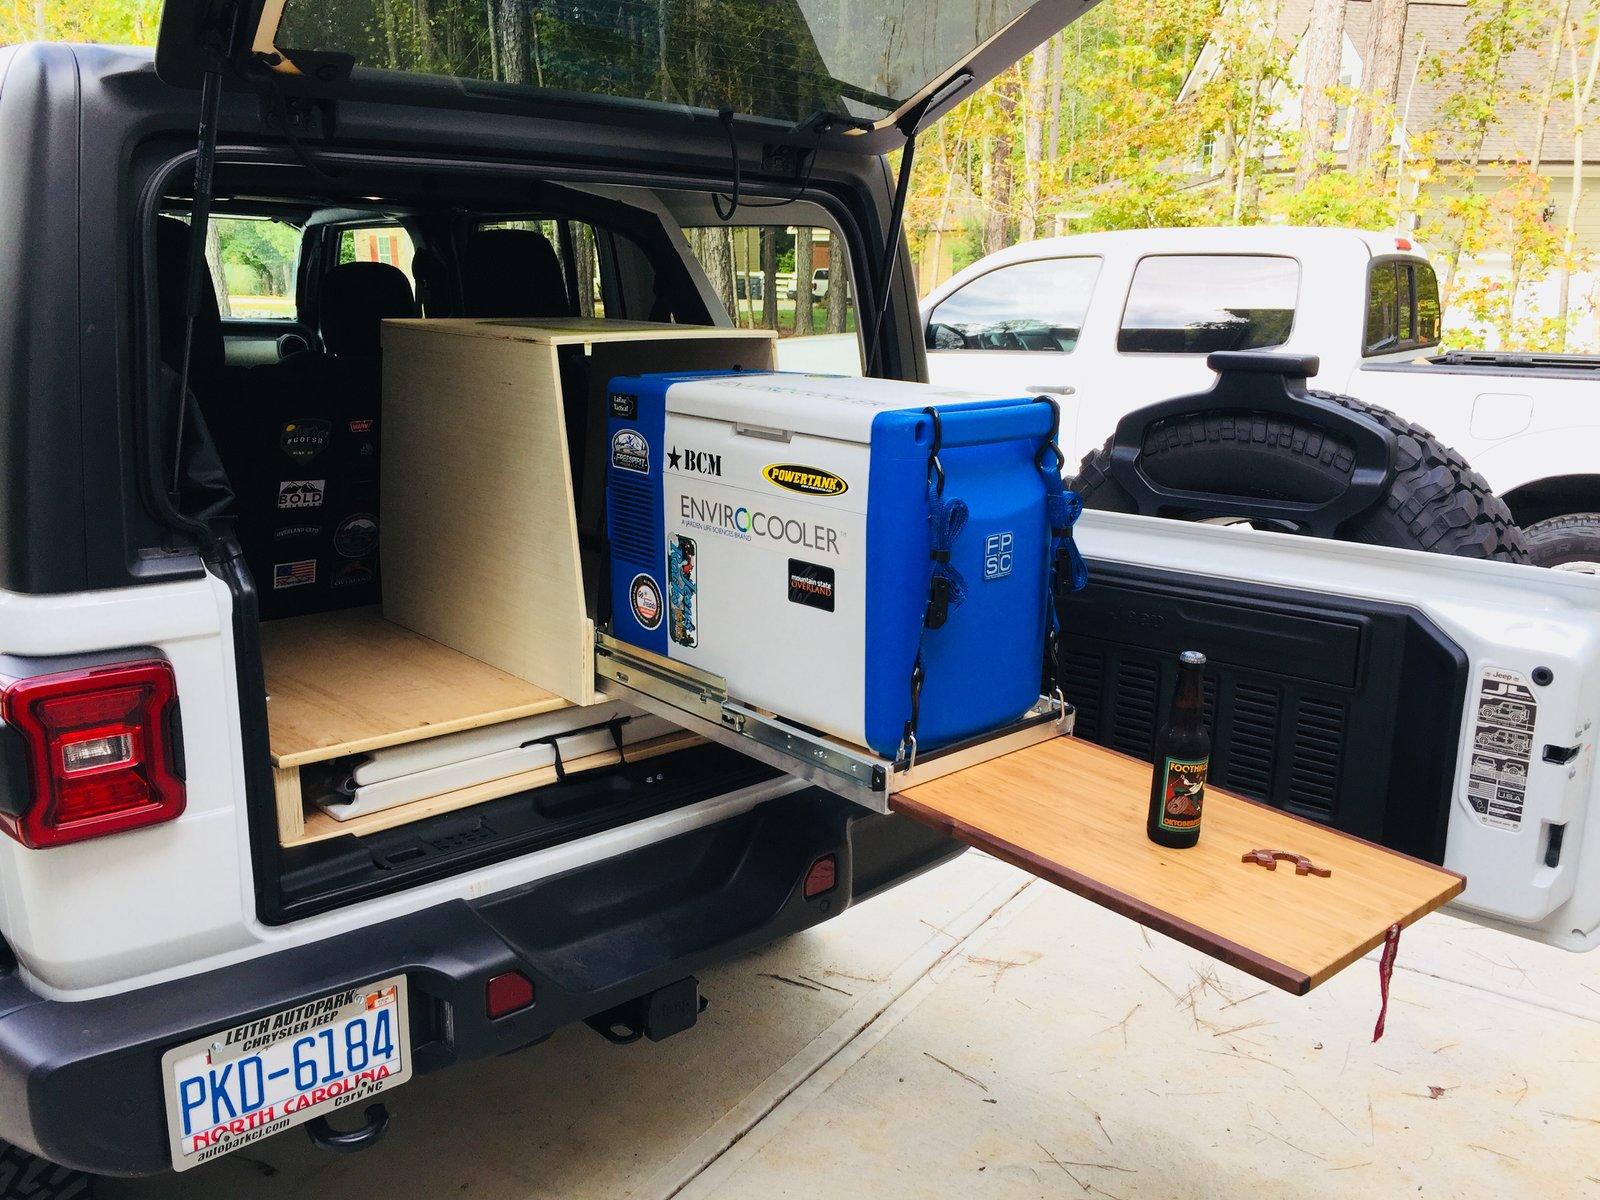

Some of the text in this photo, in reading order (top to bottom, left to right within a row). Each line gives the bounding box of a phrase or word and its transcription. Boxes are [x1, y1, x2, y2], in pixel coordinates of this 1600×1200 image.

[684, 449, 722, 477] BCM
[771, 467, 838, 490] POWERTANK
[278, 493, 322, 505] BOLD
[680, 495, 840, 555] ENVIROCOOLER
[791, 574, 832, 589] mountain state
[791, 580, 832, 597] OVERLAND
[1492, 671, 1512, 681] Jeep
[224, 989, 357, 1047] LEITH AUTOPARK
[242, 1010, 339, 1052] CHRYSLER JEEP
[179, 1008, 394, 1136] PKD-6184
[192, 1064, 391, 1152] NORTH CAROLINA
[334, 1081, 383, 1108] Cary NC
[197, 1118, 291, 1163] autoparkcj.com
